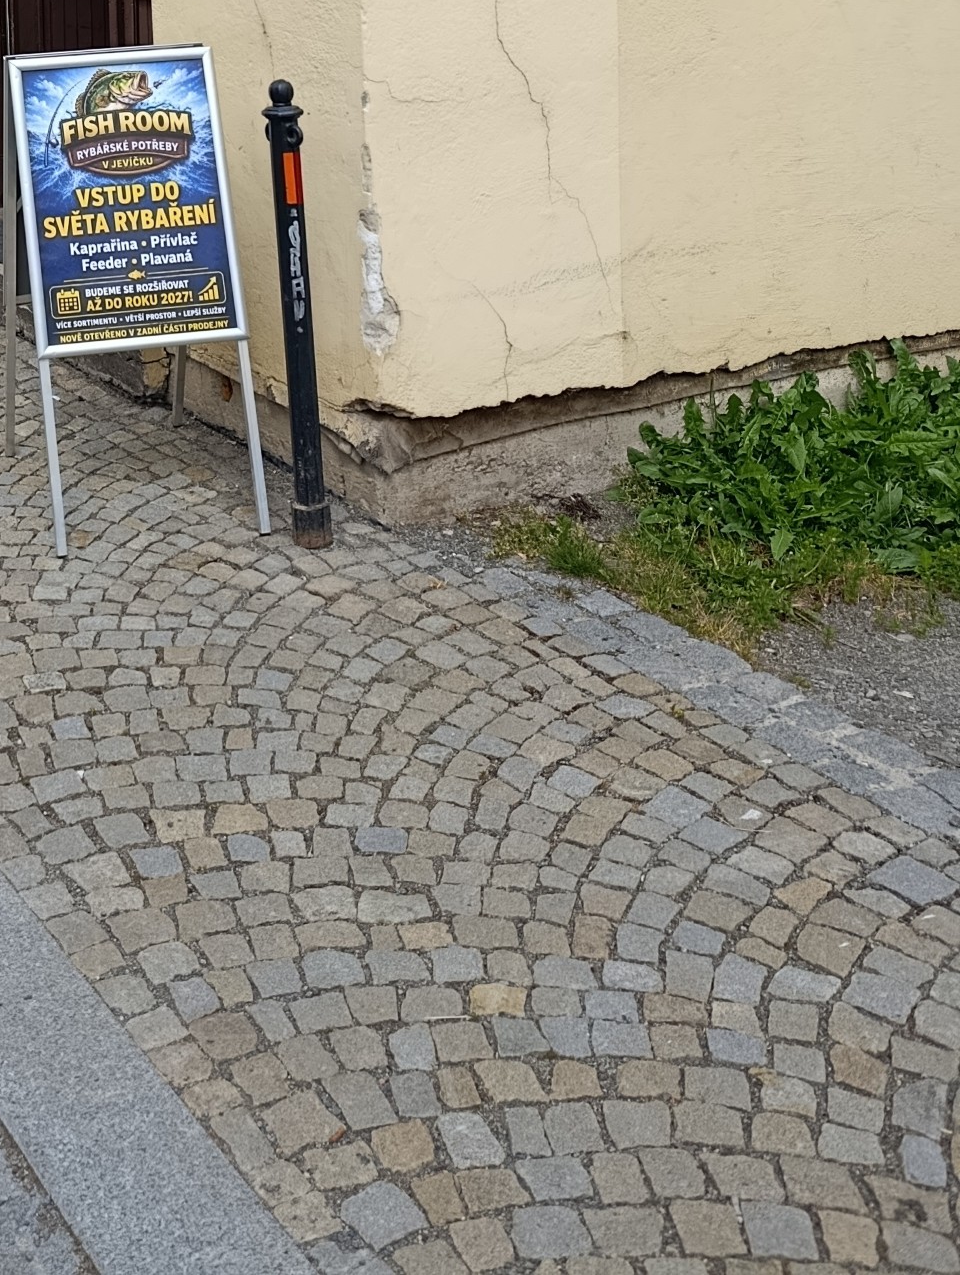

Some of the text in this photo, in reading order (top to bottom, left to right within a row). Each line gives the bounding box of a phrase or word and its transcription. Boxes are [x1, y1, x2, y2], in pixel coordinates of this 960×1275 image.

[62, 111, 192, 145] FISH ROOM
[76, 138, 179, 161] RYBÁŘSKÉ POTŘEBY
[102, 156, 154, 169] V JEVÍČKU
[75, 181, 180, 208] VSTUP DO
[43, 198, 217, 239] SVĚTA RYBAŘENÍ
[69, 231, 198, 257] Kaprařina Přívlač
[81, 250, 193, 272] Feeder Plavaná
[85, 279, 189, 298] BUDEME SE ROZŠIŘOVAT
[86, 291, 194, 312] AŽ DO ROKU 2027!
[56, 306, 227, 330] VÍCE SORTIMENTU VĚTŠÍ PROSTOR LEPŠÍ SLUŽBY
[84, 328, 127, 341] OTEVŘENO
[128, 329, 135, 337] V
[137, 325, 162, 336] ZADNÍ
[163, 322, 187, 333] ČÁSTI
[188, 319, 229, 331] PRODEJNY
